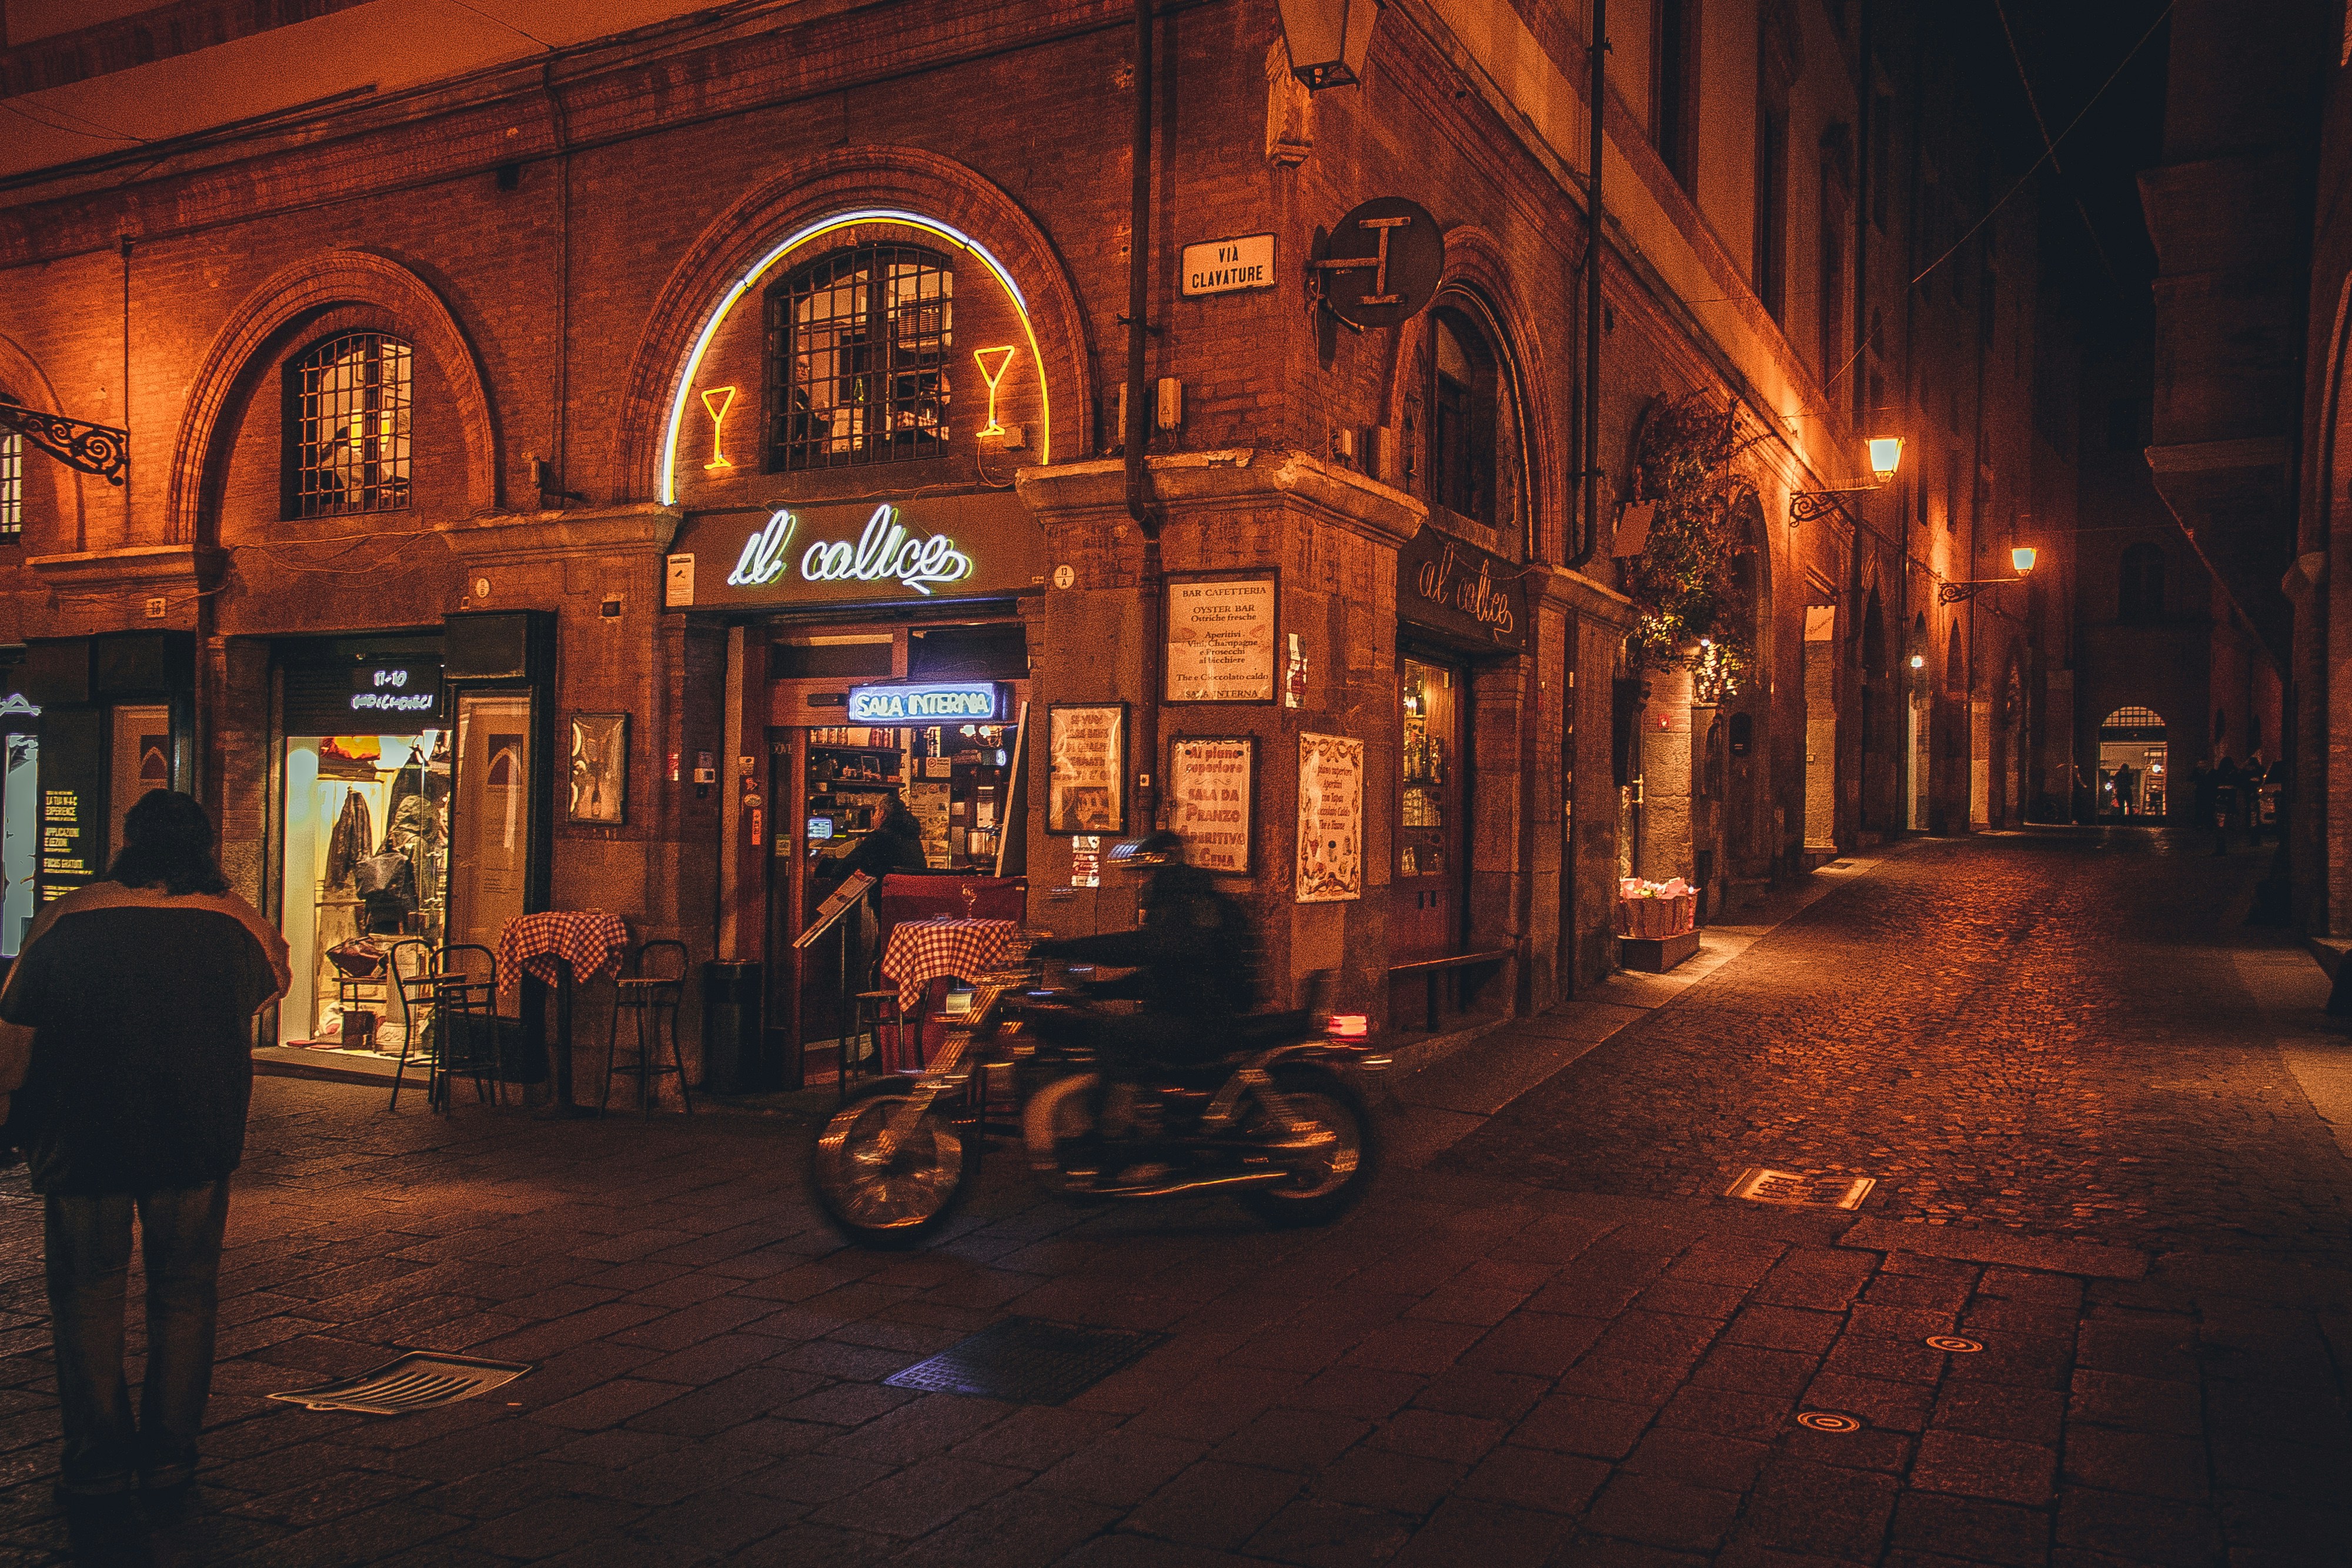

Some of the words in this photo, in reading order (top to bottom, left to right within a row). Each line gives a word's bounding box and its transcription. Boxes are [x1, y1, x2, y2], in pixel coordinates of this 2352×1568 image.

[1192, 265, 1263, 289] CLAVATURE
[801, 504, 966, 594] calice
[1061, 567, 1068, 576] 13
[1061, 578, 1067, 587] A
[1182, 589, 1202, 597] BAR
[1205, 587, 1267, 596] CAFETTERIA
[1192, 606, 1231, 614] OYSTER
[1191, 614, 1225, 622] Ostriche
[1227, 613, 1257, 621] fresche
[1205, 630, 1241, 641] Aperitivi
[1208, 639, 1258, 648] Champagne
[1185, 690, 1209, 698] SAA
[856, 694, 904, 717] SALA
[908, 693, 990, 716] INTERNA
[1205, 745, 1240, 762] piano
[1188, 788, 1218, 801] SALA
[1222, 789, 1240, 802] DA
[1185, 803, 1240, 823] PRANZO
[1177, 825, 1245, 845] APERITIVO
[1200, 847, 1235, 867] CENA
